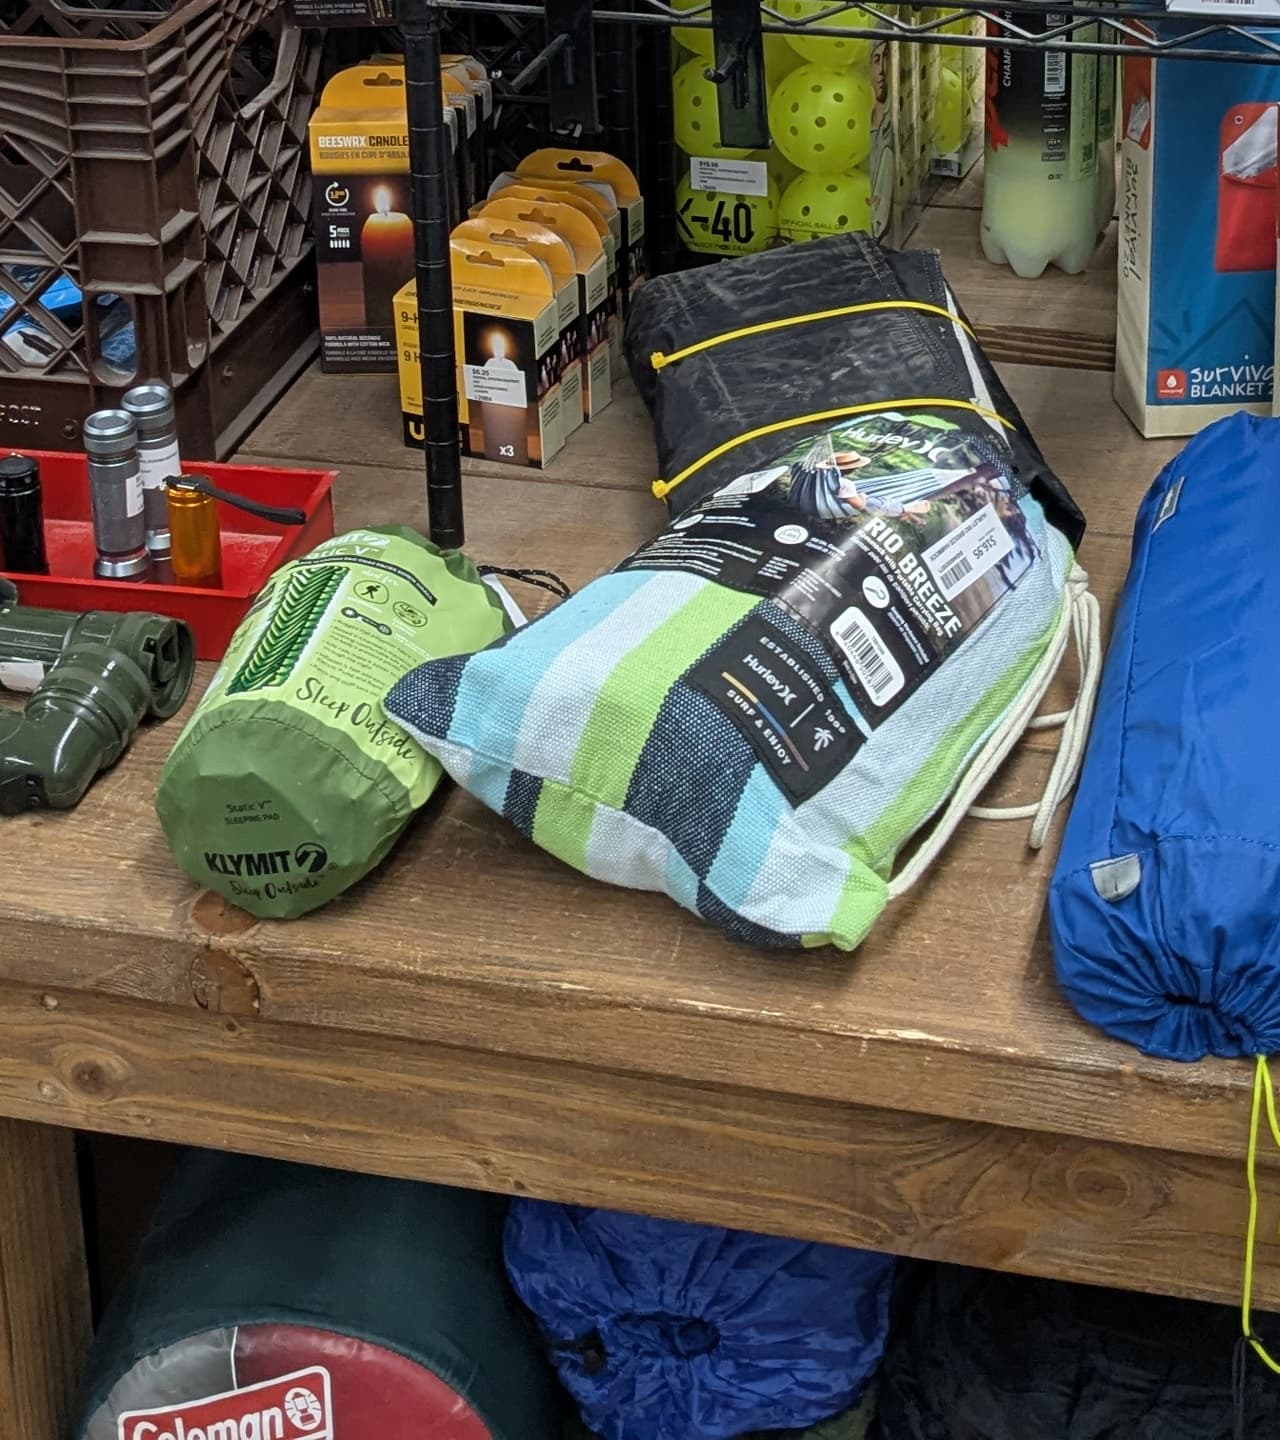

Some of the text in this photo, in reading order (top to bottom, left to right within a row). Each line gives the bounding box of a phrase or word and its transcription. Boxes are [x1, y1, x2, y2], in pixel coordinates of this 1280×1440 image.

[1190, 382, 1265, 399] BLANKET
[864, 516, 963, 640] RIO BREEZE
[295, 676, 418, 762] Sleep Outside
[204, 850, 292, 878] KLYMIT
